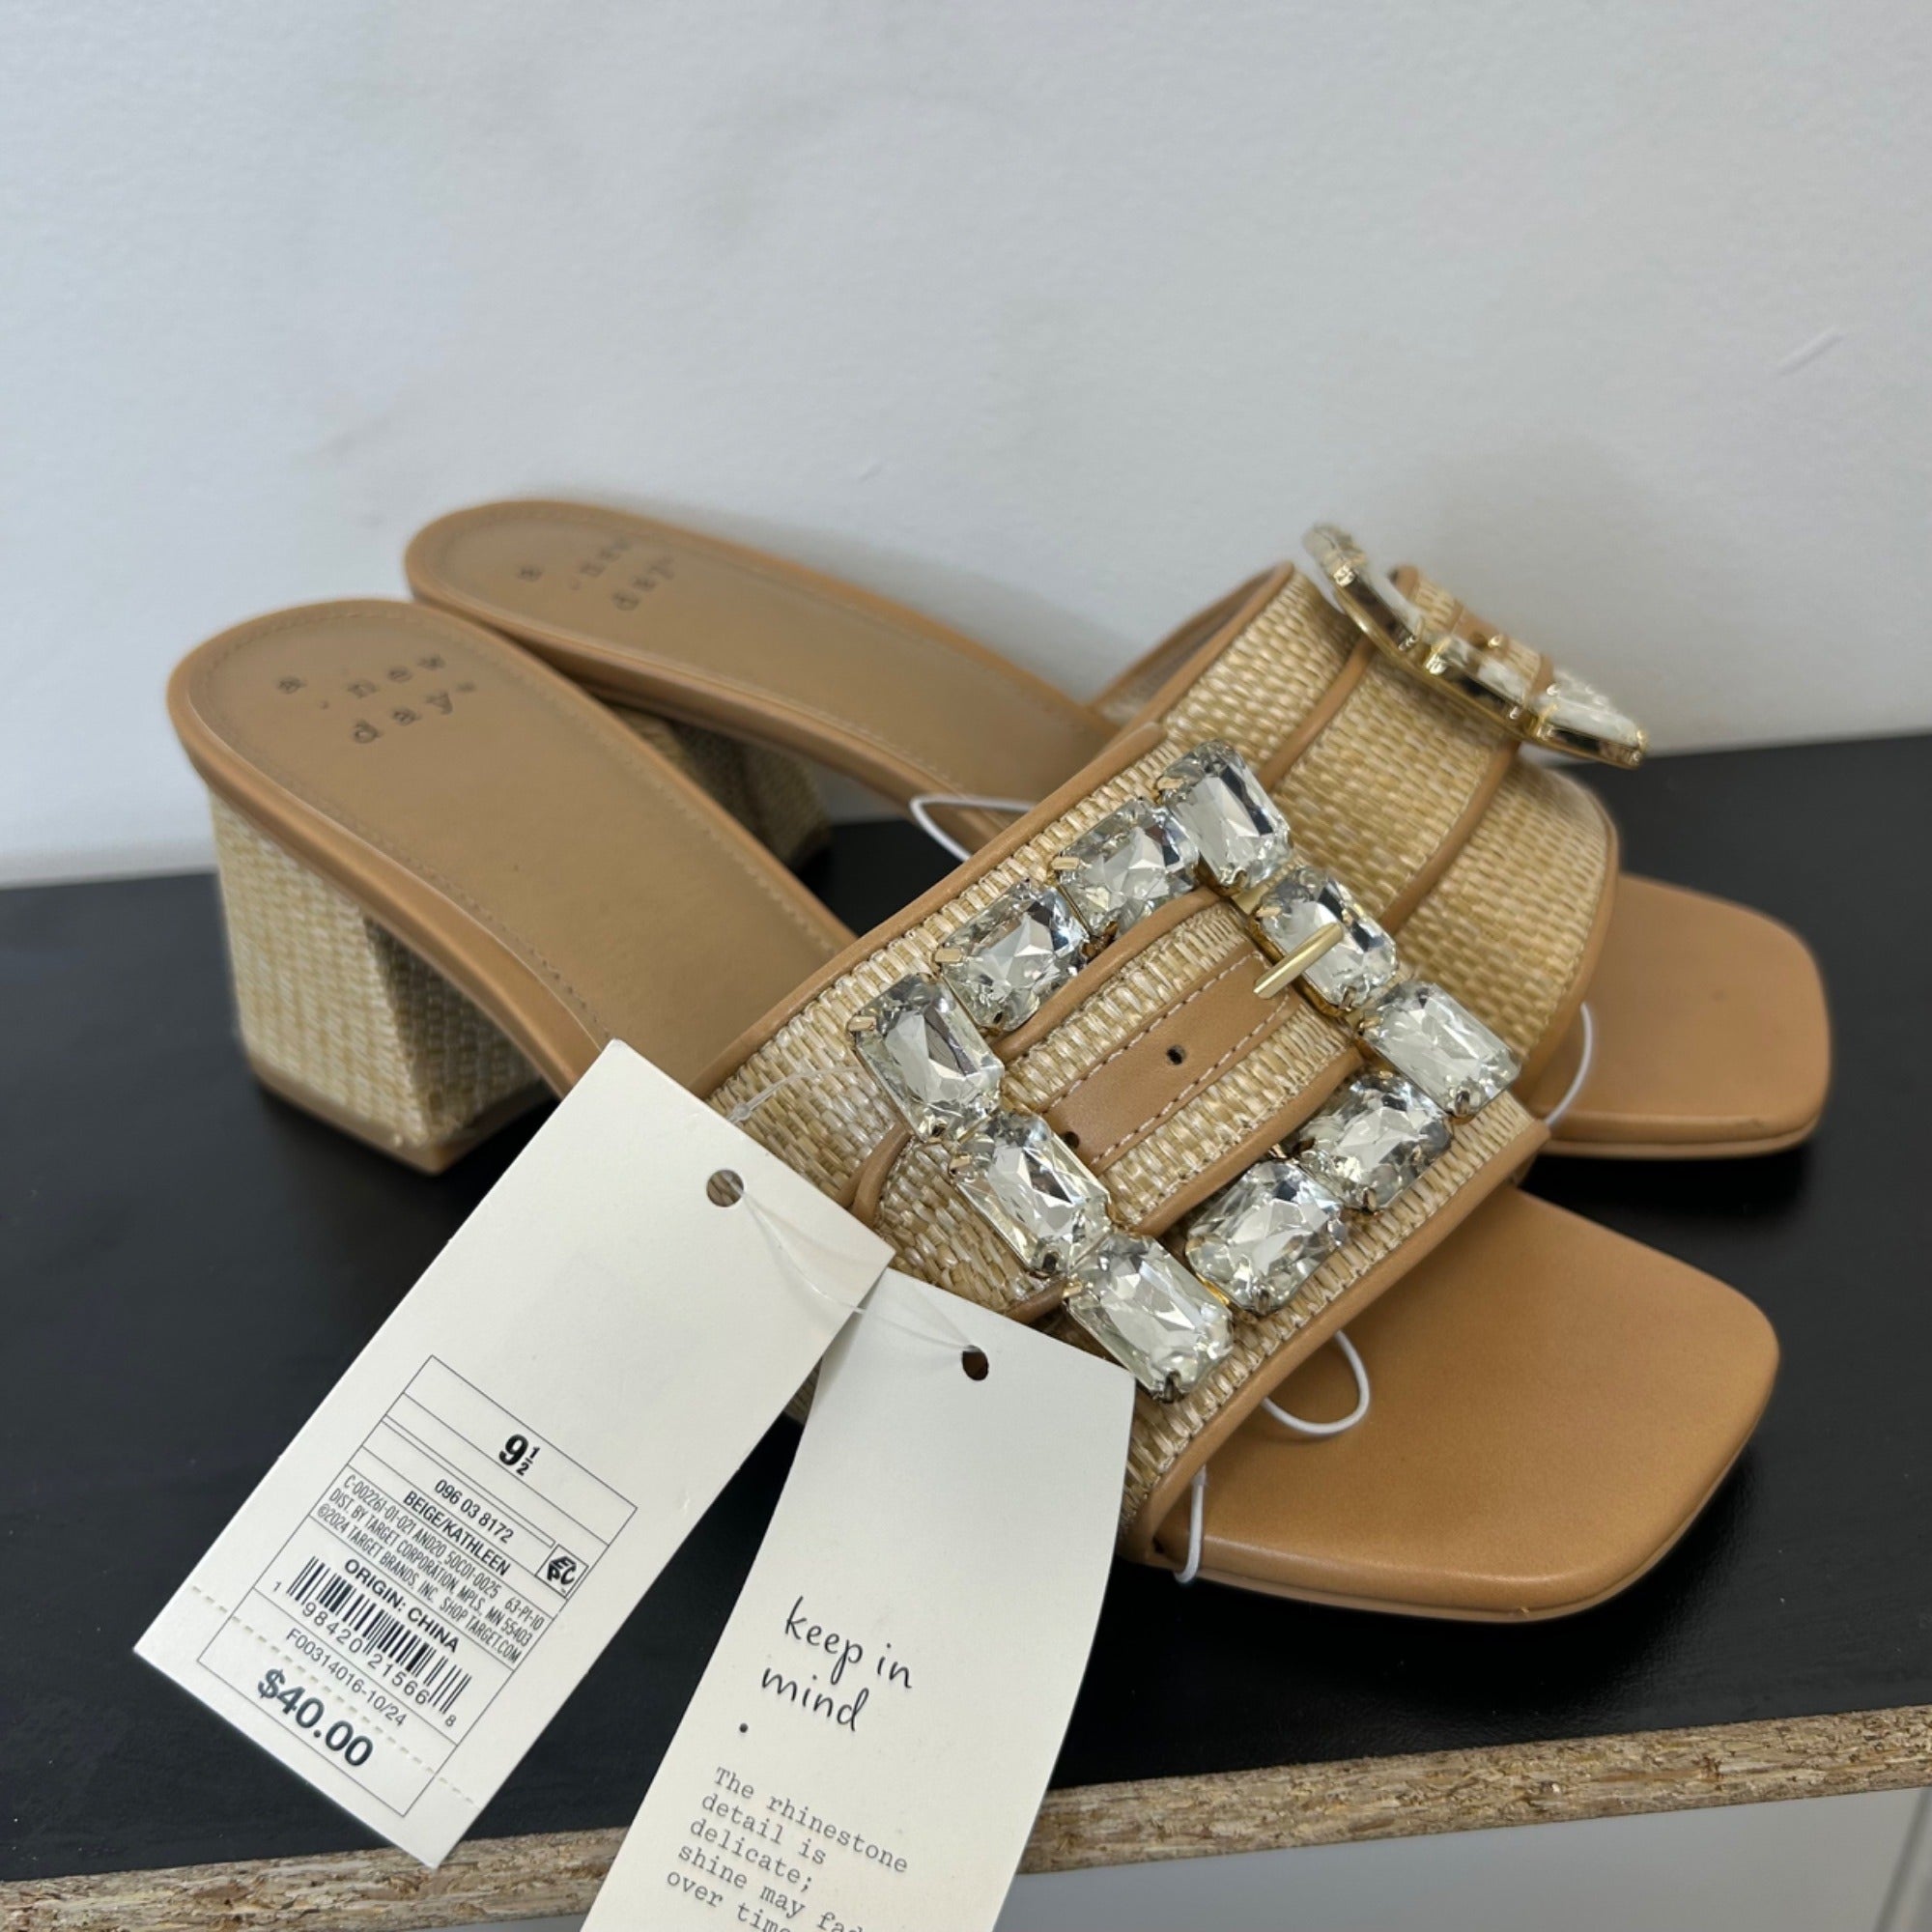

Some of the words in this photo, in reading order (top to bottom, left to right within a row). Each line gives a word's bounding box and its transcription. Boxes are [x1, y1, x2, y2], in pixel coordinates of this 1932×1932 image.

[403, 1490, 511, 1577] BEIGE/KATHLEEN
[435, 1479, 463, 1504] 096
[460, 1498, 481, 1519] 03
[478, 1512, 514, 1544] 8172
[328, 1488, 355, 1515] DIST.
[351, 1505, 370, 1523] BY
[364, 1514, 401, 1546] TARGET
[484, 1606, 505, 1627] MN
[500, 1618, 533, 1647] 55403
[344, 1558, 406, 1611] ORIGIN:
[408, 1606, 460, 1653] CHINA
[346, 1522, 384, 1558] TARGET
[417, 1579, 439, 1603] INC.
[440, 1597, 469, 1623] SHOP
[465, 1616, 522, 1663] TARGET.COM
[286, 1628, 408, 1727] F00314016-10/24
[302, 1602, 363, 1654] 98420
[367, 1654, 430, 1705] 21566
[444, 1715, 457, 1727] 8
[784, 1596, 864, 1685] keep
[876, 1642, 912, 1689] in
[257, 1668, 374, 1767] $40.00
[761, 1667, 869, 1732] mind
[690, 1818, 812, 1892] delicate;
[701, 1793, 783, 1846] detail
[798, 1838, 827, 1865] is
[713, 1767, 754, 1799] The
[766, 1796, 909, 1873] rhinestone
[667, 1871, 724, 1908] over
[678, 1844, 748, 1889] shine
[759, 1886, 806, 1918] may
